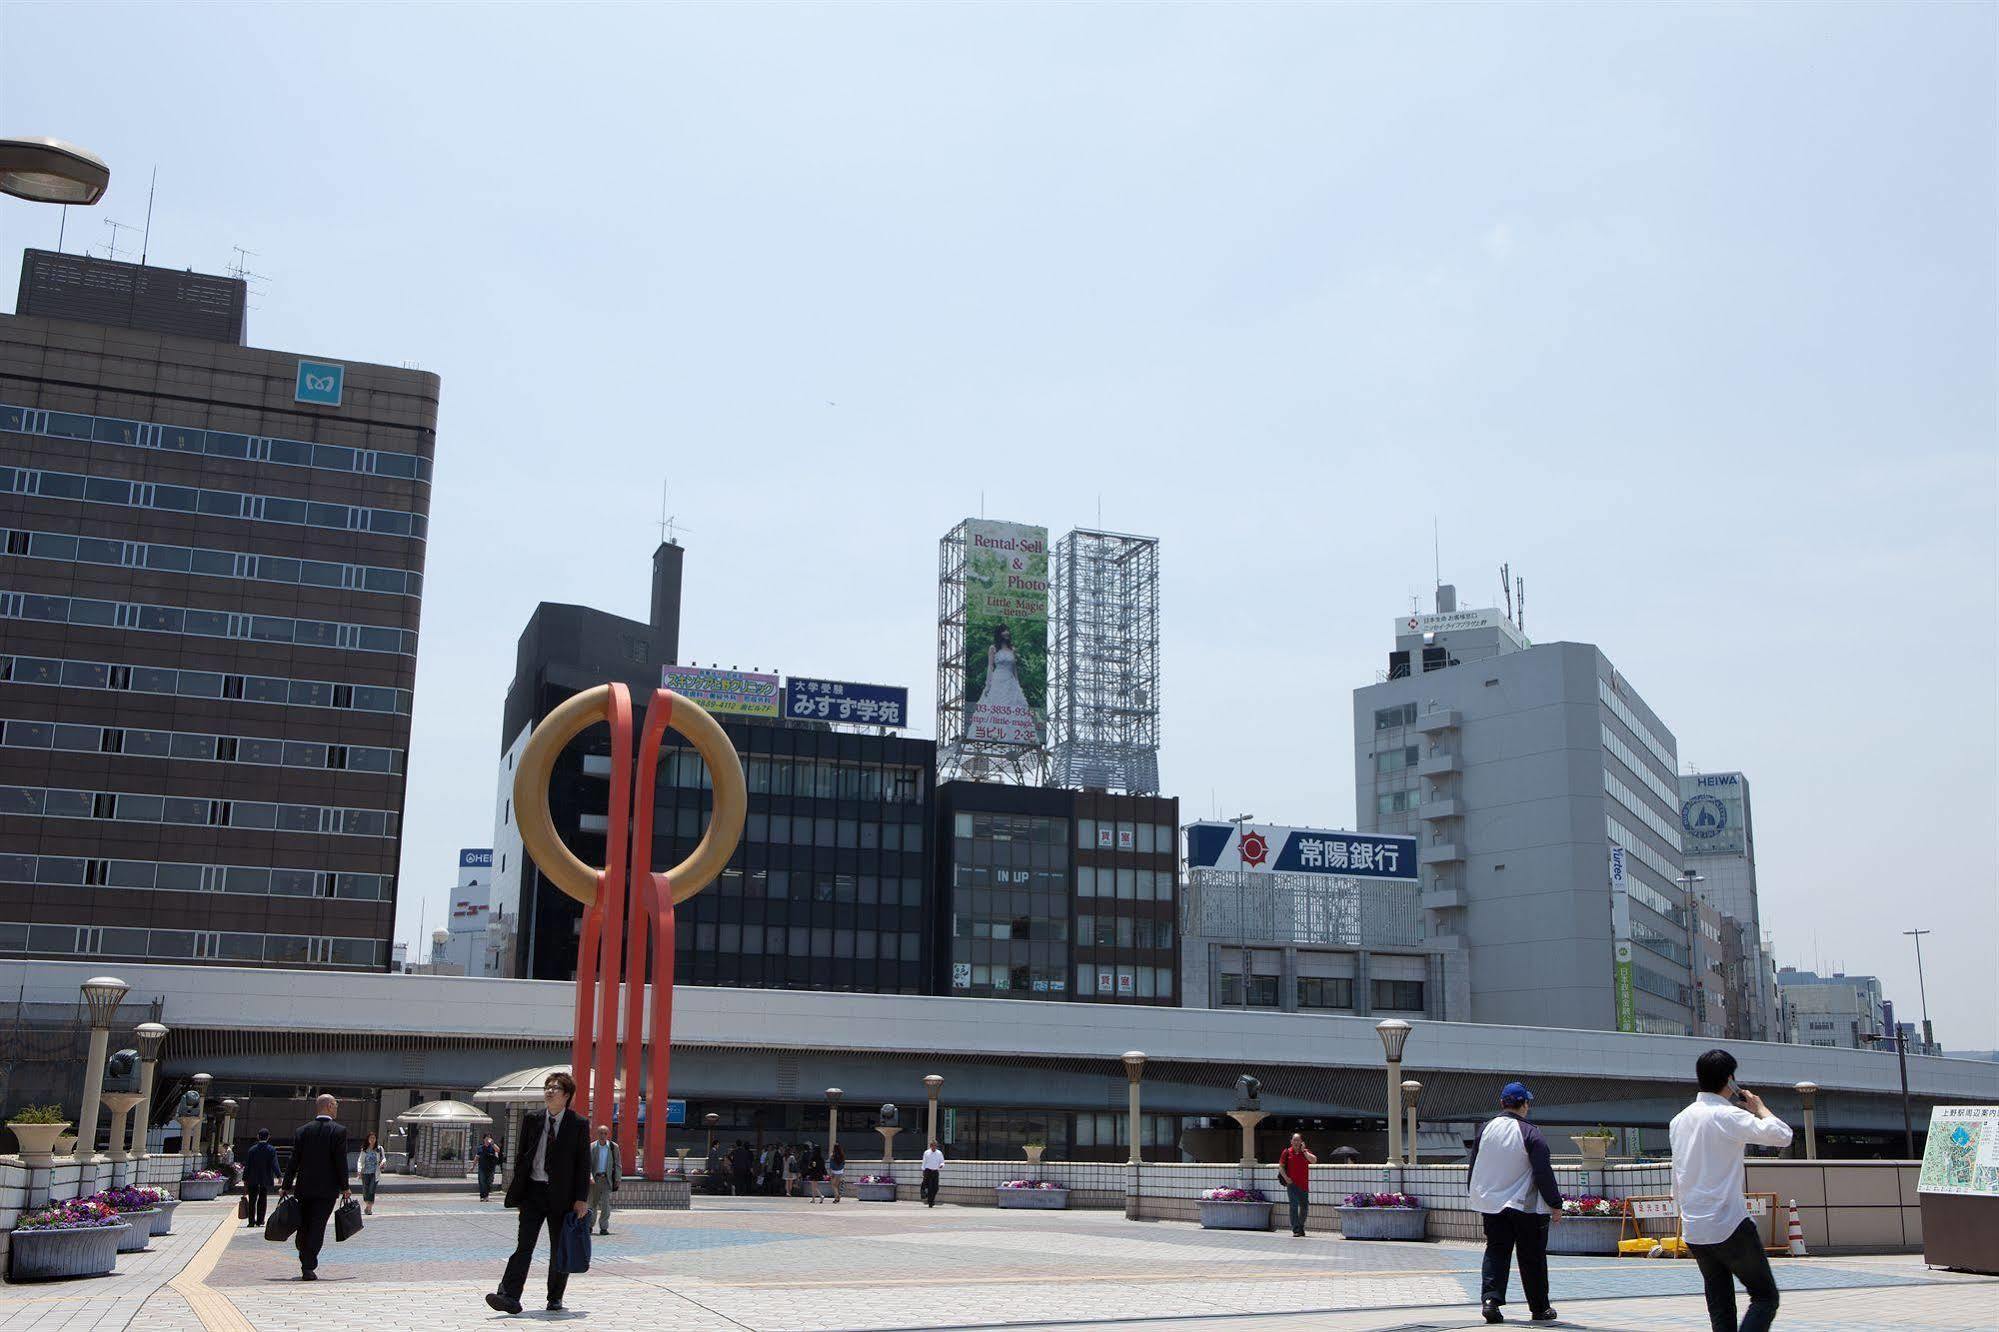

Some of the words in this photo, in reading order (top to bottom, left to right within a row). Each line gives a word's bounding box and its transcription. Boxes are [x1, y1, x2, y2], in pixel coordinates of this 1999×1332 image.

[1012, 557, 1023, 570] &
[1008, 575, 1046, 591] Photo
[795, 681, 844, 695] 大学受験
[793, 695, 900, 723] みすず学苑
[976, 726, 1007, 738] 当ビル
[1697, 775, 1738, 787] HEIWA
[1299, 838, 1399, 872] 常陽銀行
[997, 870, 1009, 882] IN
[1013, 871, 1029, 883] UP
[1942, 1108, 1999, 1118] 上野駅周辺案内
